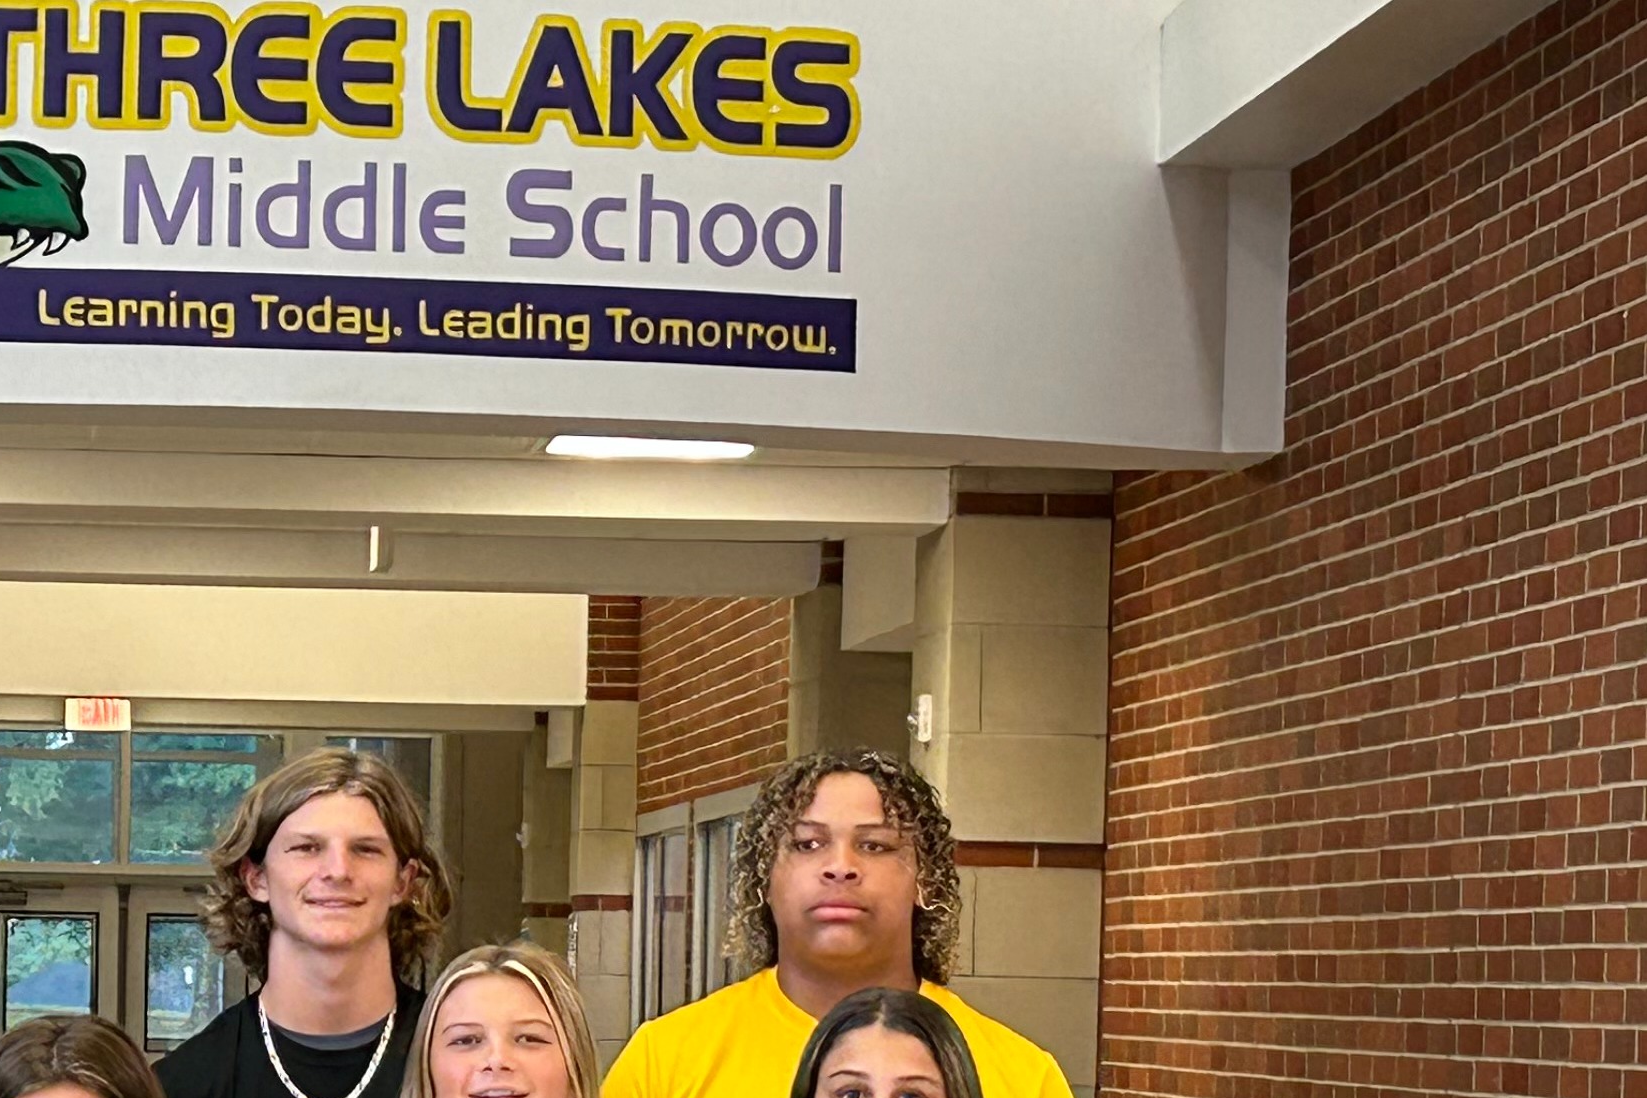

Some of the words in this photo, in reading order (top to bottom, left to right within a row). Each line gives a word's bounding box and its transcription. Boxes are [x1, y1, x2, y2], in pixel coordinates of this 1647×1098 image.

[428, 9, 860, 159] LAKES
[122, 154, 466, 254] Middle
[505, 168, 843, 273] School
[38, 289, 235, 338] Learning
[251, 293, 403, 344] Today.
[418, 299, 591, 351] Leading
[605, 306, 837, 356] Tomorrow.
